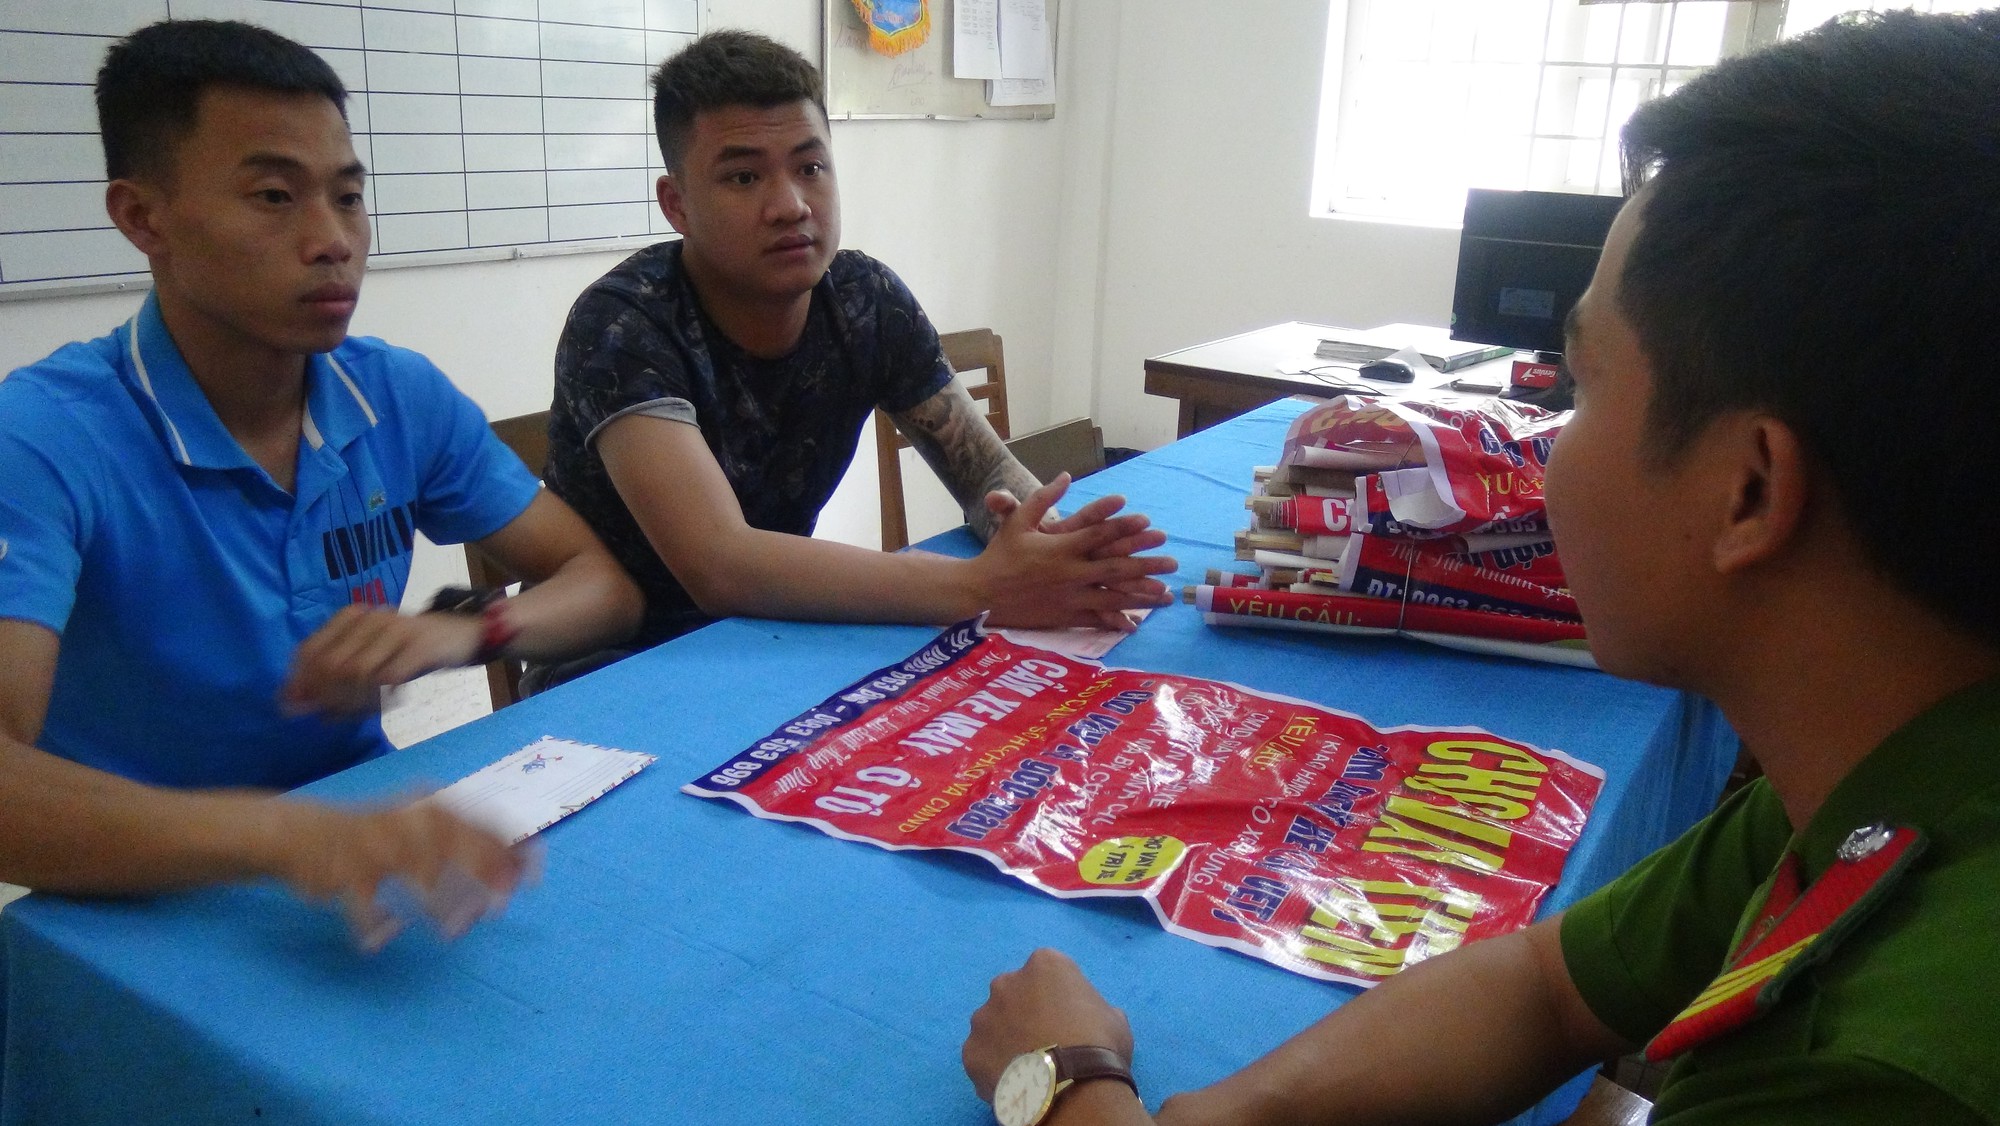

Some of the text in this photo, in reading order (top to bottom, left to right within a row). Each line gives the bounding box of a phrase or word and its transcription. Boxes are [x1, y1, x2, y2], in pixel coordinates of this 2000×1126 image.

[1230, 595, 1284, 618] YÊU
[956, 690, 1022, 721] XE
[901, 711, 987, 758] MÁY
[1277, 715, 1319, 746] YÊU
[748, 735, 799, 762] 563
[708, 760, 762, 788] 896
[855, 765, 918, 789] Ô
[999, 758, 1060, 801] góp
[1404, 740, 1547, 820] CHO
[815, 784, 893, 817] TÔ
[898, 798, 949, 834] CMND
[1361, 795, 1512, 873] VAY
[1131, 850, 1161, 867] VAY
